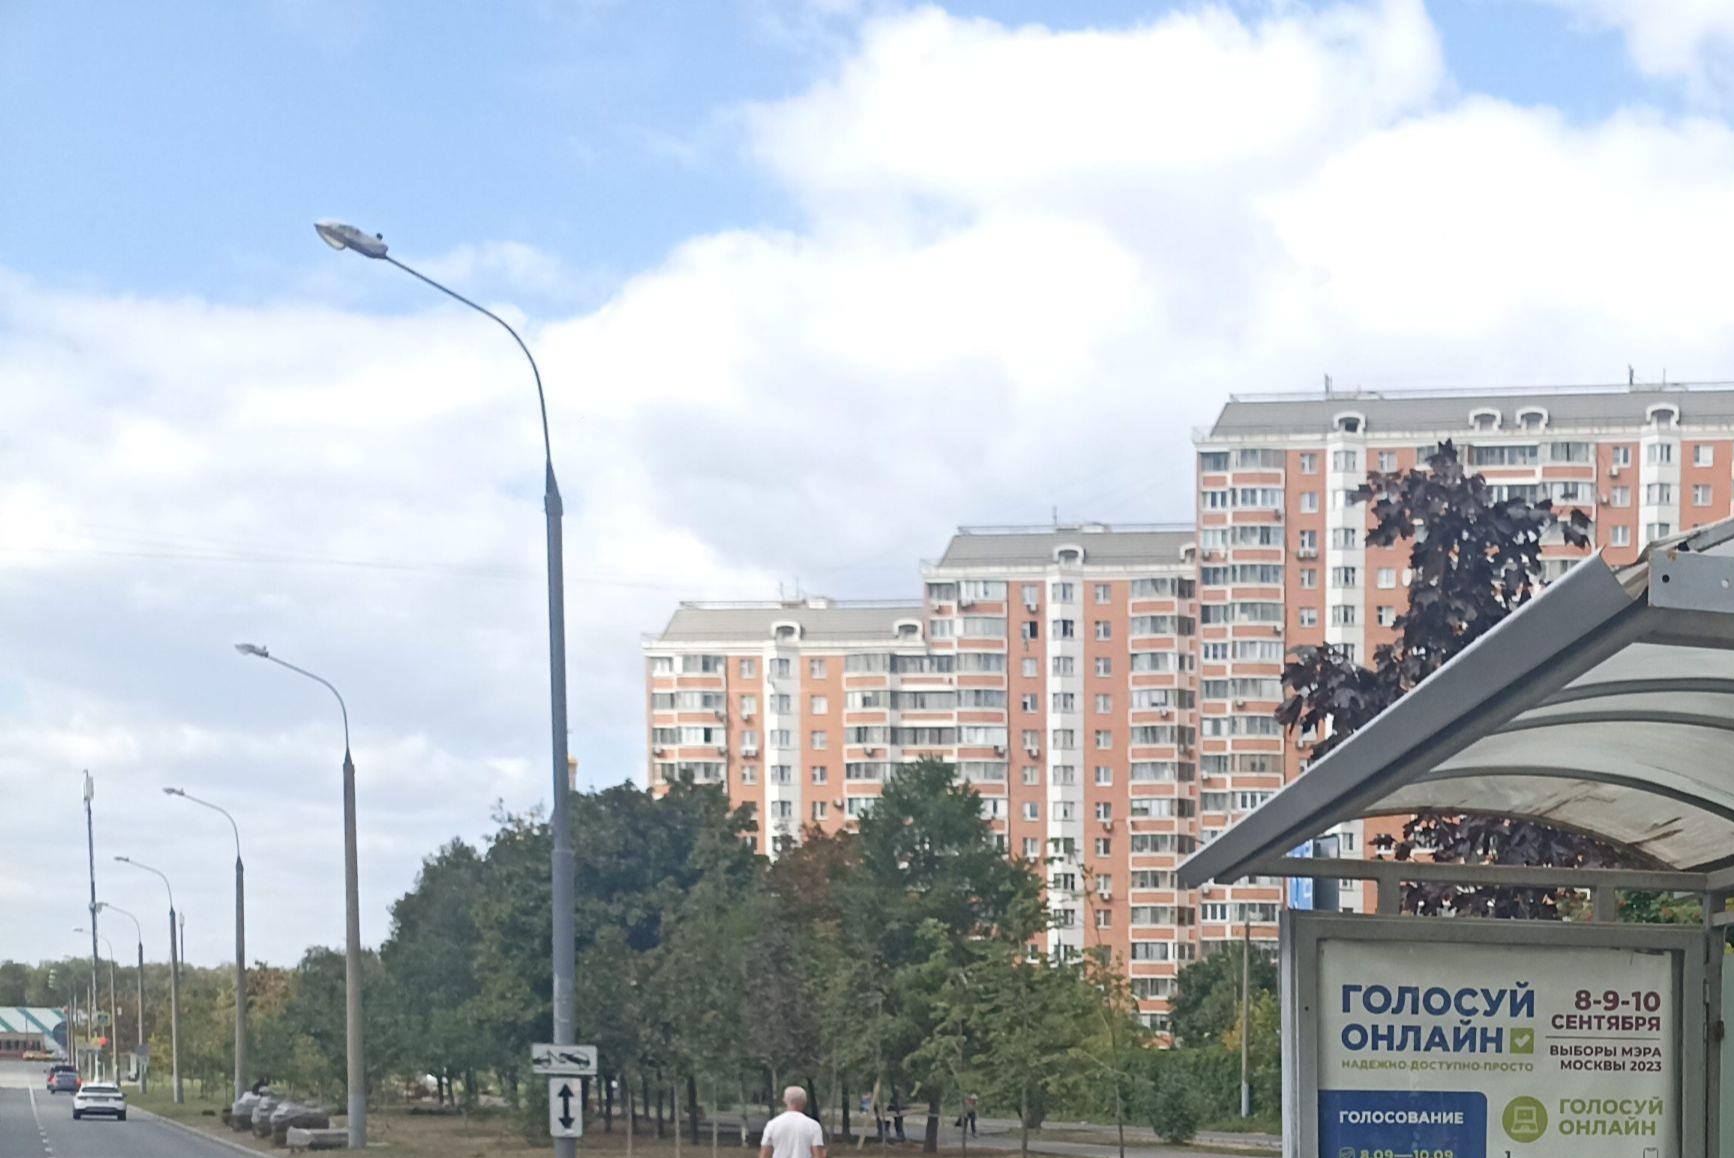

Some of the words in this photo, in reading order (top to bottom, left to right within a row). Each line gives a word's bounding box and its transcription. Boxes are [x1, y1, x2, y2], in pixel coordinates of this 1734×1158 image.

[1342, 981, 1535, 1018] ГОЛОСУЙ
[1575, 990, 1661, 1012] 8-9-10
[1552, 1015, 1660, 1031] СЕНТЯБРЯ
[1342, 1019, 1503, 1053] ОНЛАЙН
[1550, 1045, 1617, 1057] ВЫБОРЫ
[1622, 1047, 1662, 1058] МЭРА
[1561, 1060, 1625, 1071] МОСКВЫ
[1630, 1061, 1662, 1072] 2023
[1560, 1096, 1663, 1115] ГОЛОСУЙ
[1340, 1111, 1464, 1124] ГОЛОСОВАНИЕ
[1559, 1117, 1656, 1136] ОНЛАЙН
